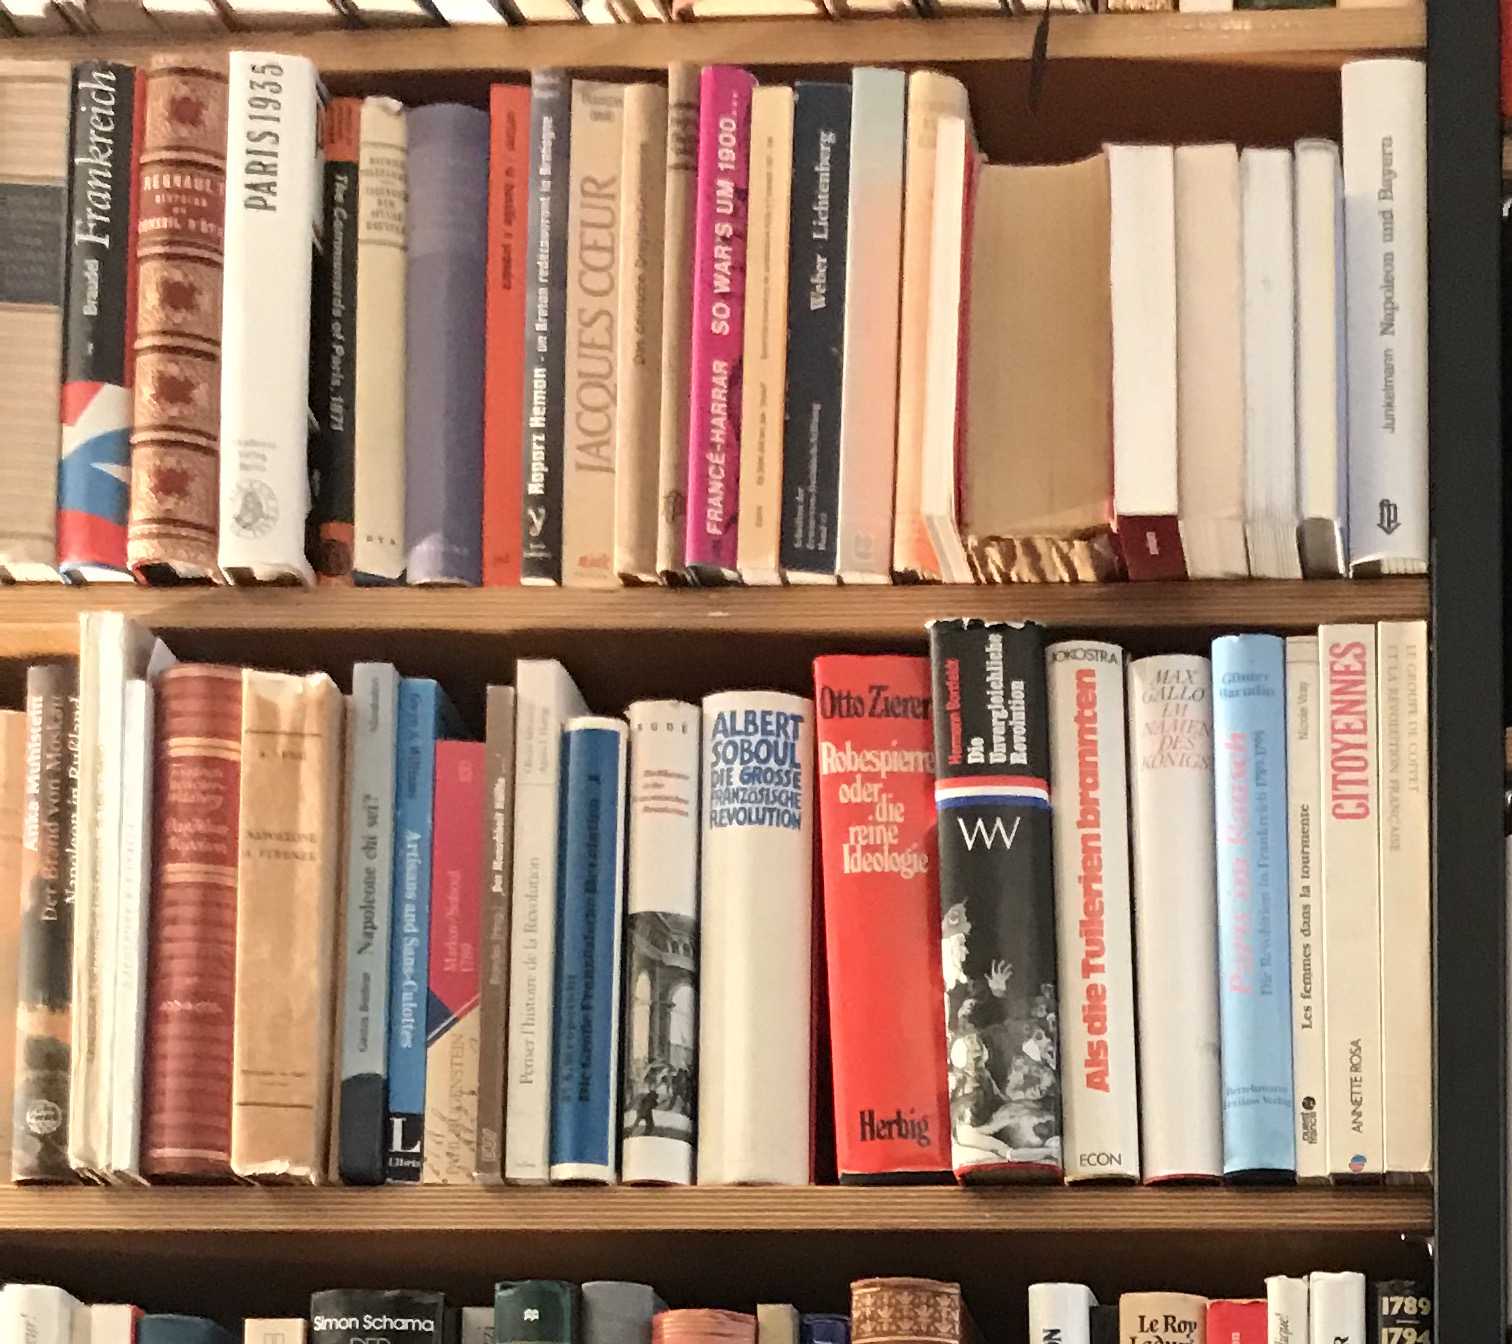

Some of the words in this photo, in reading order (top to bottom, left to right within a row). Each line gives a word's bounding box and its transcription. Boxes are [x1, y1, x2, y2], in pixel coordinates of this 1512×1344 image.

[249, 63, 283, 122] 1935
[718, 90, 738, 171] 1900...
[73, 71, 116, 248] Frankreich
[243, 131, 279, 211] PARIS
[811, 129, 835, 240] Lichtenberg
[715, 179, 734, 215] UM
[576, 175, 616, 298] CŒUR
[713, 223, 733, 294] WAR'S
[809, 254, 827, 310] Weber
[711, 303, 730, 336] SO
[575, 308, 617, 475] JACQUES
[705, 359, 729, 535] FRANCÉ-HARRAR
[711, 710, 804, 741] ALBERT
[711, 740, 802, 767] SOBOUL
[1073, 669, 1100, 828] brannten
[1329, 641, 1369, 820] CITOYENNES
[1298, 803, 1310, 880] tourmente
[1078, 833, 1105, 979] Tuilerien
[1299, 885, 1310, 898] la
[1300, 904, 1311, 937] dans
[1300, 943, 1312, 1000] femmes
[1082, 985, 1106, 1035] die
[1301, 1005, 1313, 1030] Les
[1085, 1040, 1110, 1092] Als
[859, 1109, 931, 1146] Herbig
[1079, 1153, 1122, 1166] ECON
[313, 1316, 362, 1331] Simon
[364, 1316, 435, 1331] Schama
